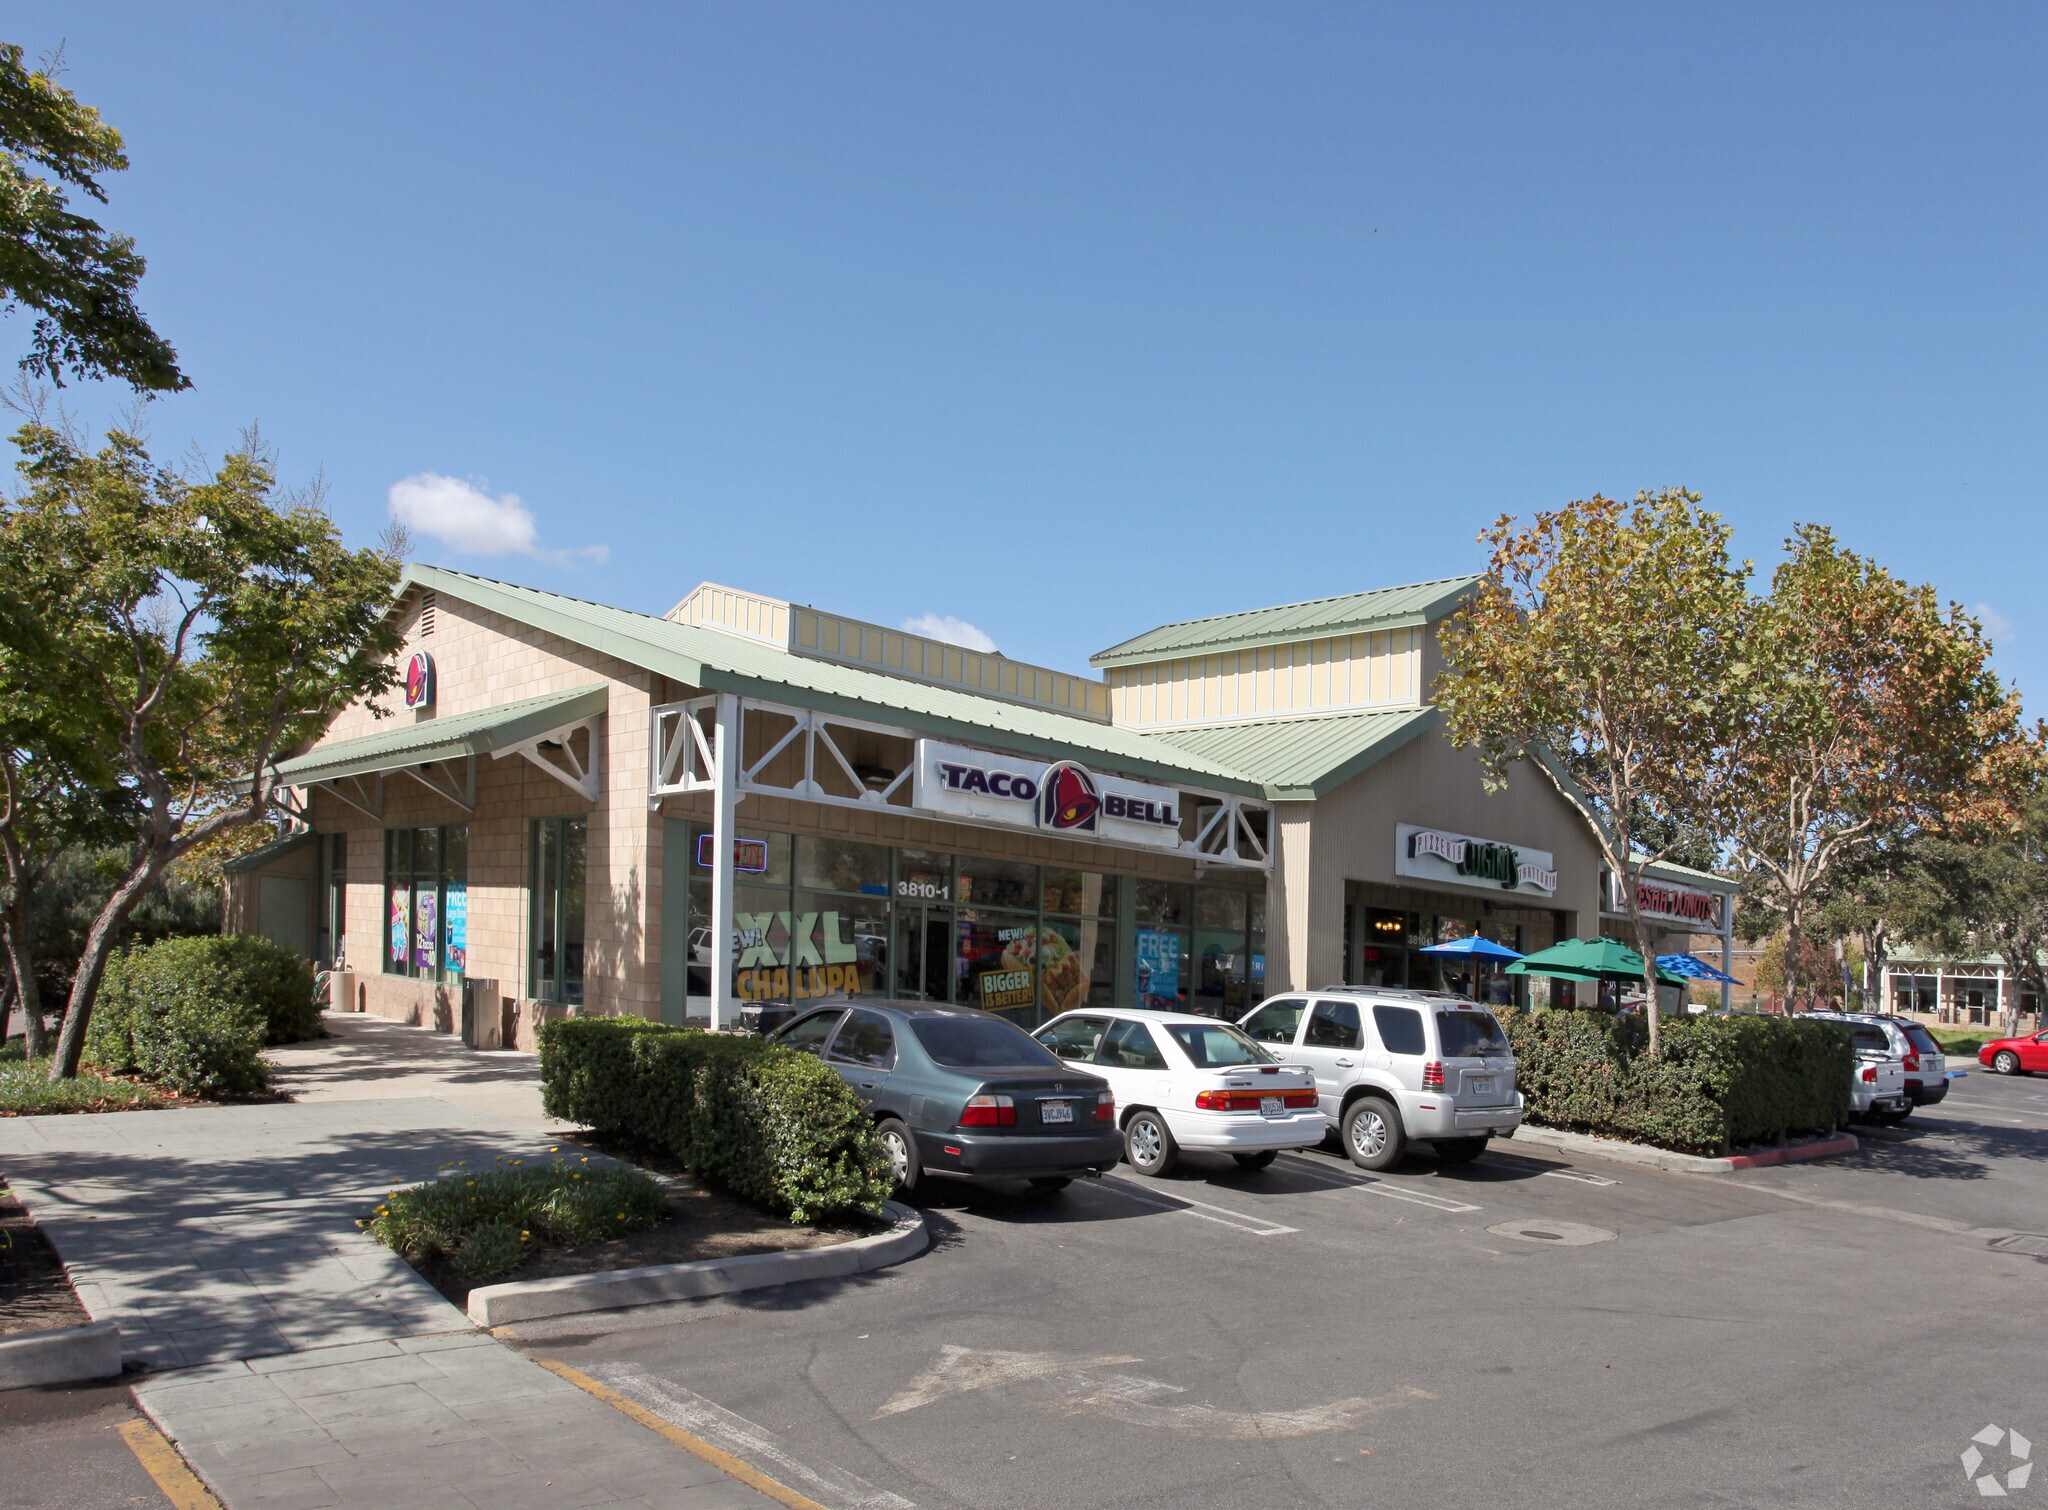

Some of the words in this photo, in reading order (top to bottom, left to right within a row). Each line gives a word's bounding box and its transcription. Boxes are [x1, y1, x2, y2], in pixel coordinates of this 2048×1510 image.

[940, 763, 1037, 800] TACO
[1104, 795, 1180, 827] BELL
[702, 837, 766, 868] OEN
[1417, 834, 1463, 861] PIZZERIA
[898, 880, 949, 900] 3810-1
[1671, 890, 1713, 918] DONUTS
[732, 929, 763, 951] EW!
[735, 911, 858, 968] XXL
[998, 927, 1024, 942] NEW!
[1138, 933, 1179, 959] FREE
[736, 965, 861, 1000] CHALUPA
[983, 970, 1030, 994] BIGGER
[985, 993, 996, 1008] IS
[996, 991, 1034, 1006] BETTER!
